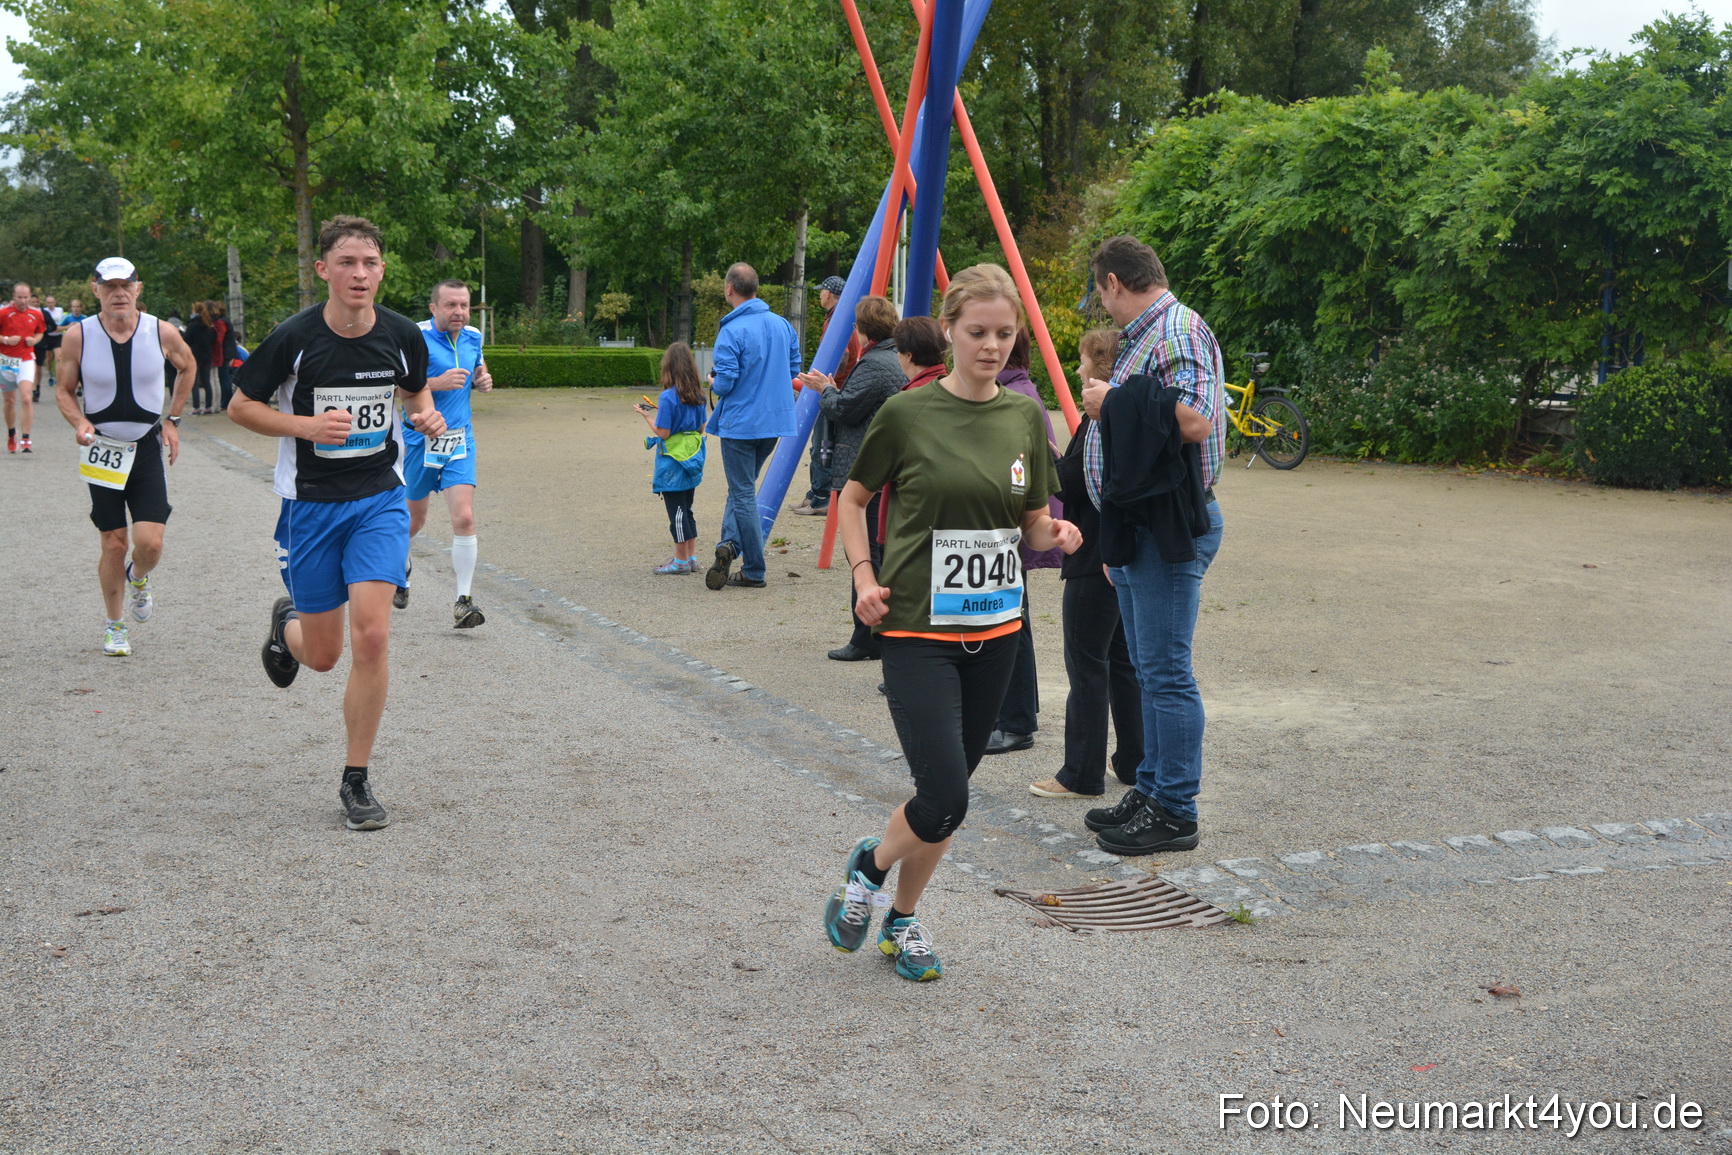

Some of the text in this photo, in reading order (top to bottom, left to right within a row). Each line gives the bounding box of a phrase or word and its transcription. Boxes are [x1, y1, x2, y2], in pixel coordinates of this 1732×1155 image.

[361, 370, 395, 379] PFLEIDERER
[316, 393, 382, 402] PARTL Neumarkt
[88, 445, 123, 469] 643
[935, 537, 1009, 549] PARTL Neumarkt
[943, 549, 1016, 589] 2040
[961, 598, 1004, 612] Andrea
